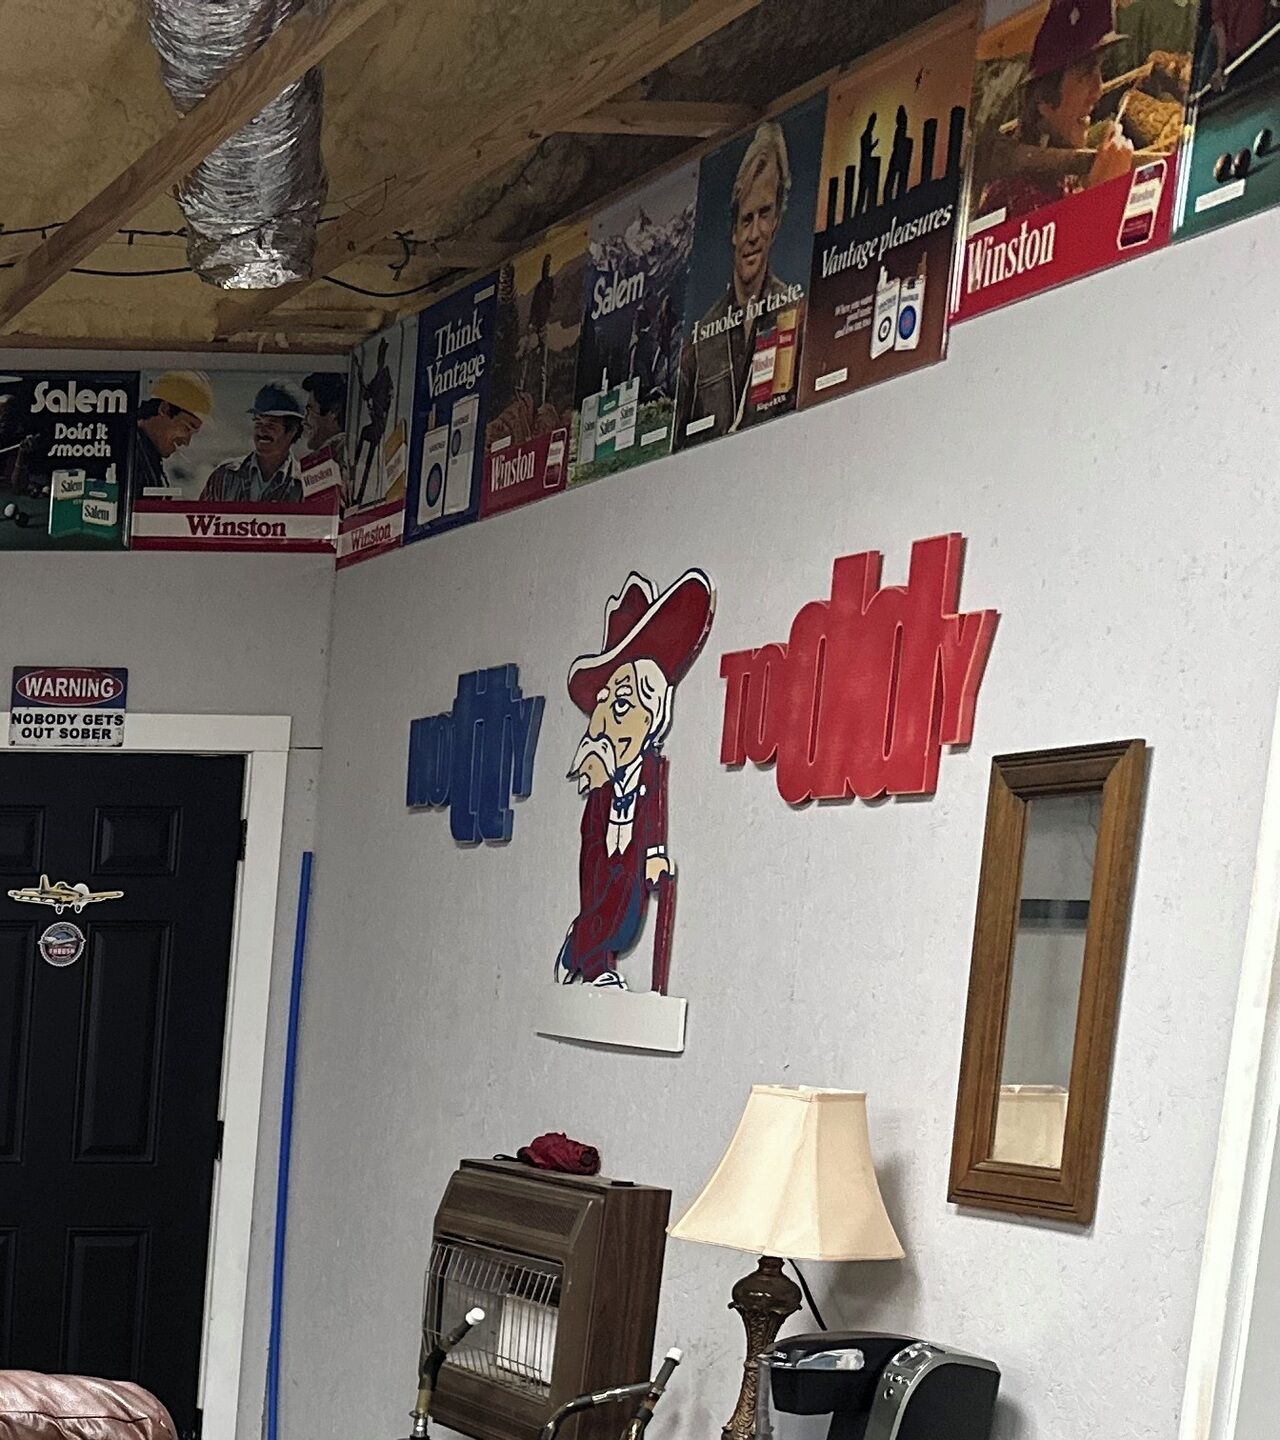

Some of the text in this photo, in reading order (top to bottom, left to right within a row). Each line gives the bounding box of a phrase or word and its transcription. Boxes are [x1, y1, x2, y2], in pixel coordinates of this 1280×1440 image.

[822, 204, 953, 279] Vantage pleasures
[967, 220, 1056, 294] Winston
[591, 270, 645, 320] Salem
[700, 305, 743, 341] smoke
[745, 294, 766, 320] for
[766, 283, 804, 312] taste.
[435, 308, 483, 360] Think
[426, 353, 486, 400] Vantage
[30, 380, 128, 414] Salem
[55, 422, 109, 440] Doin' it
[47, 441, 111, 457] smooth
[491, 448, 535, 493] Winston
[61, 479, 83, 493] Salem
[84, 503, 110, 521] Salem
[186, 514, 286, 537] Winston
[351, 522, 391, 551] Winston
[25, 677, 114, 698] WARNING
[11, 713, 124, 726] NOBODY GETS
[21, 727, 112, 739] OUT SOBER
